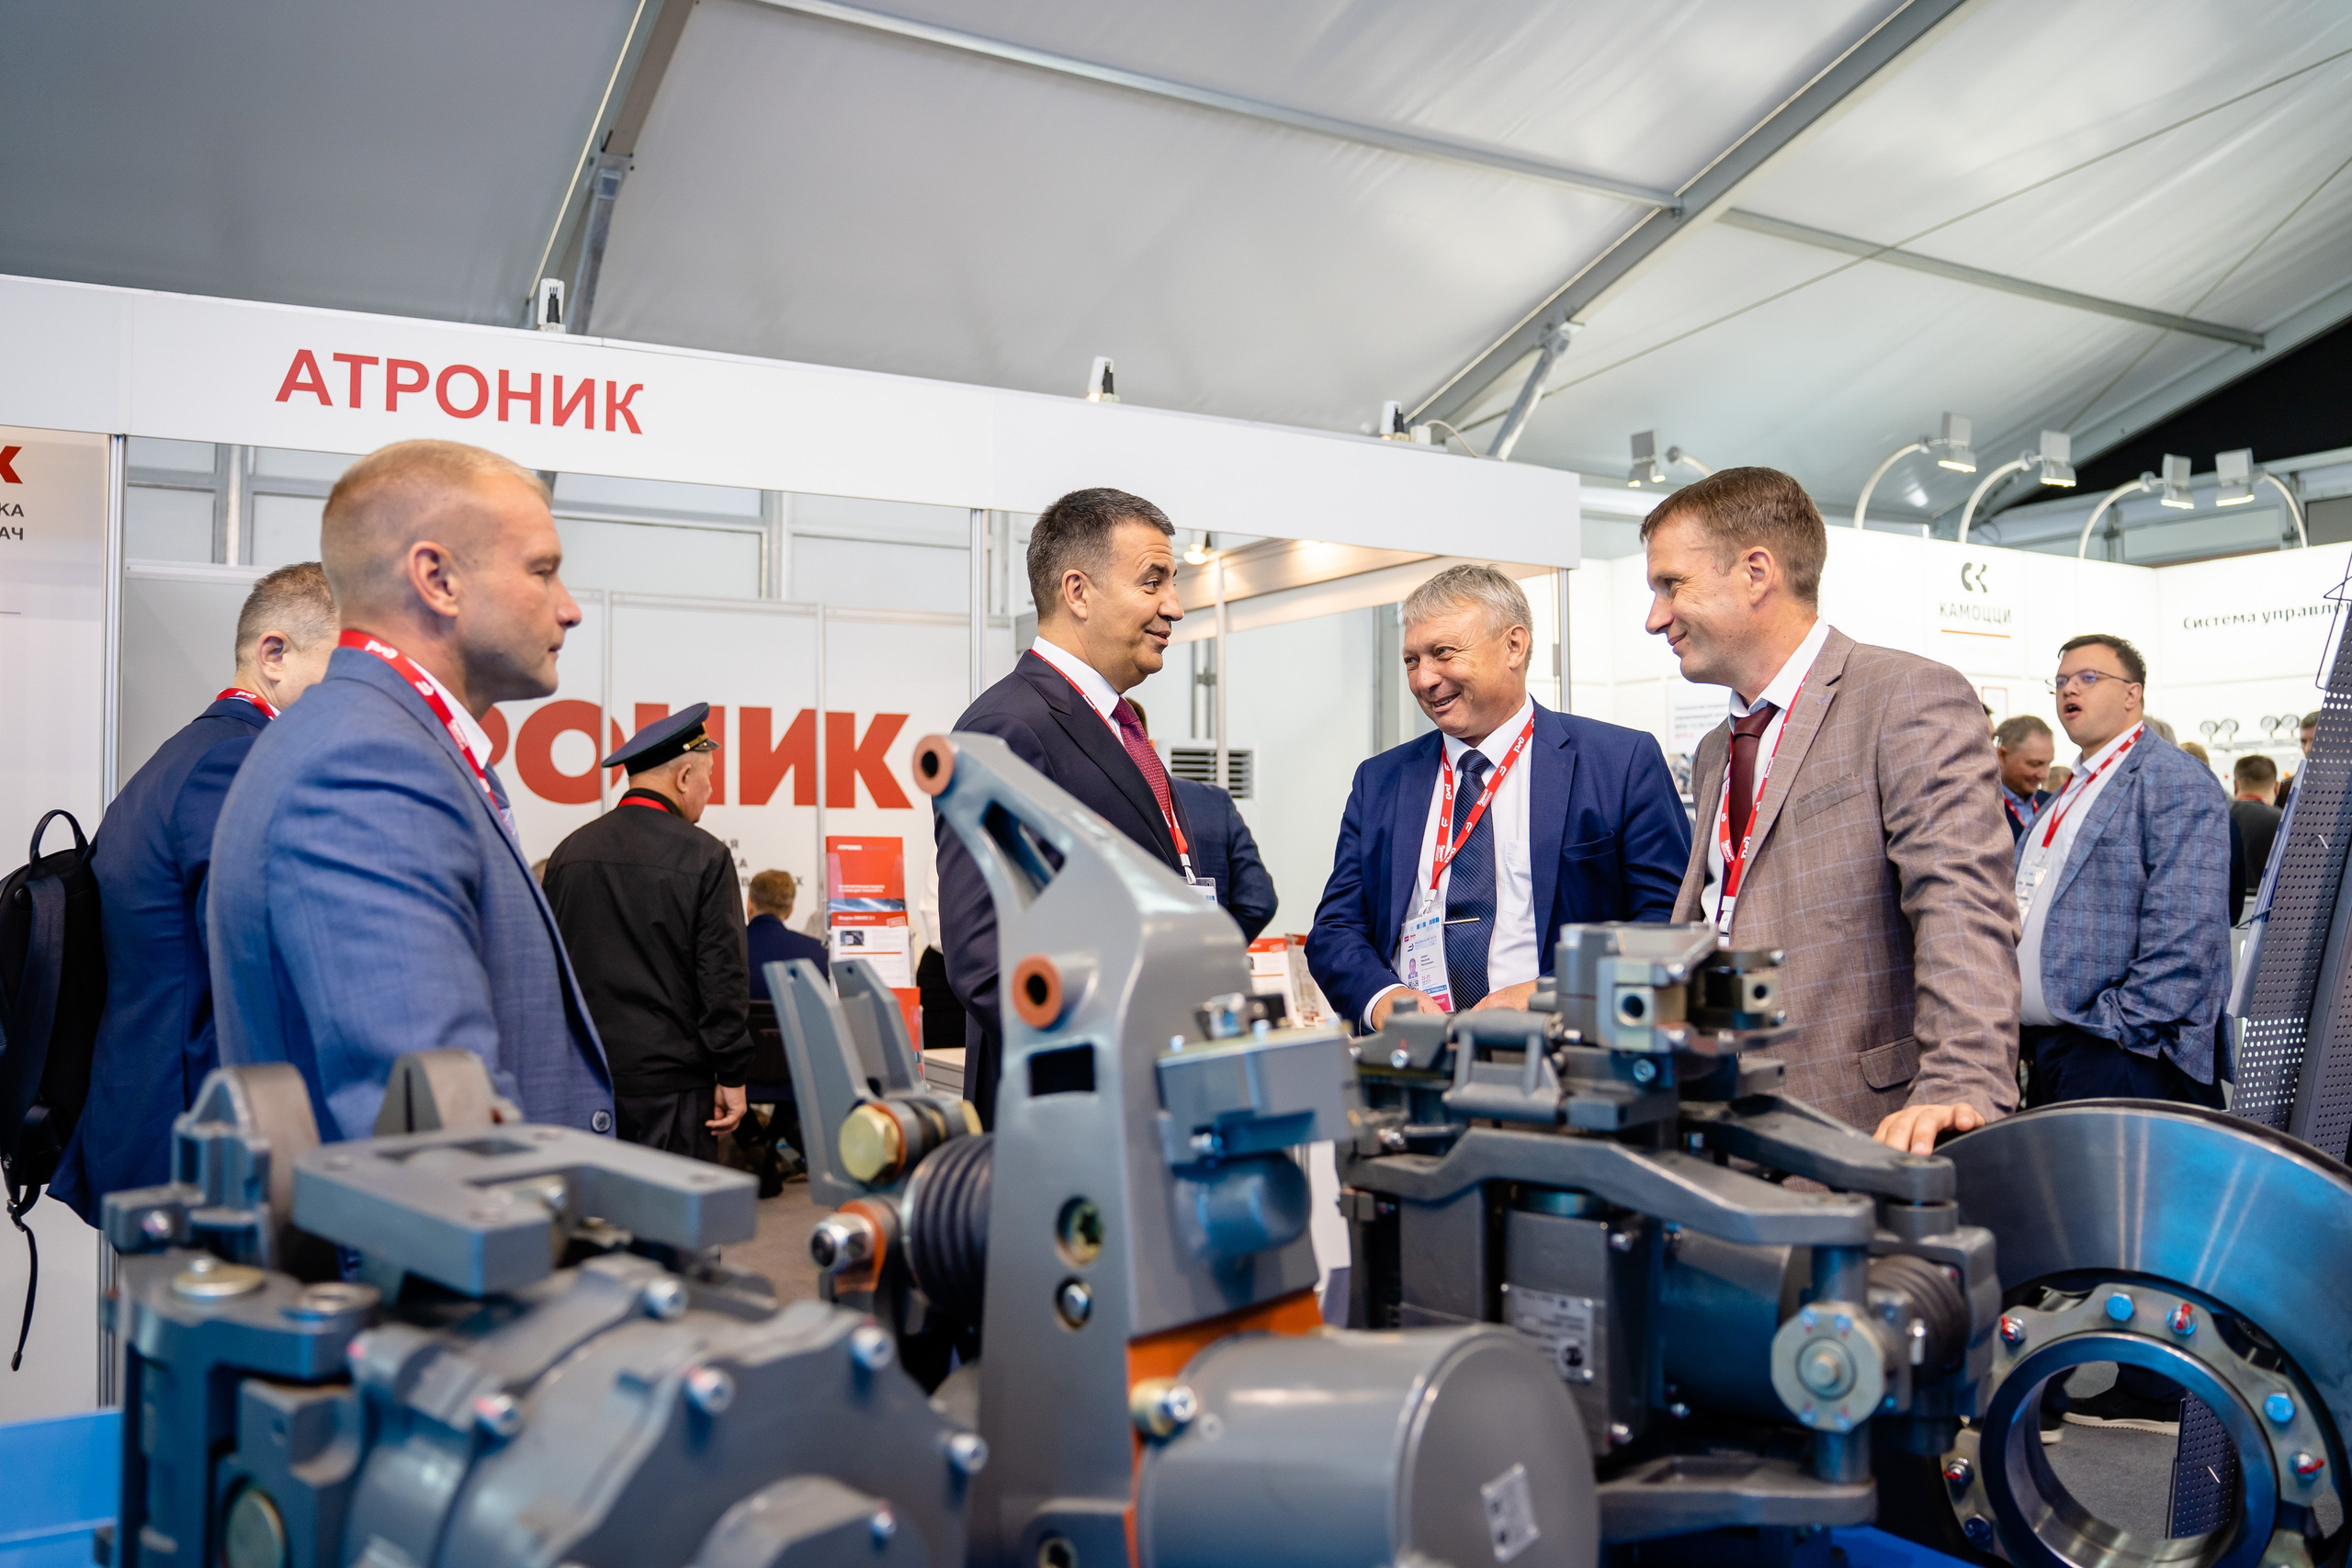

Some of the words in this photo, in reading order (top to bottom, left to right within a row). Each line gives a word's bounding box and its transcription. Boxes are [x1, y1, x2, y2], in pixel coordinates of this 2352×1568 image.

[275, 348, 644, 435] АТРОНИК
[1939, 602, 2012, 626] КАМОЦЦИ
[2183, 613, 2256, 631] Система
